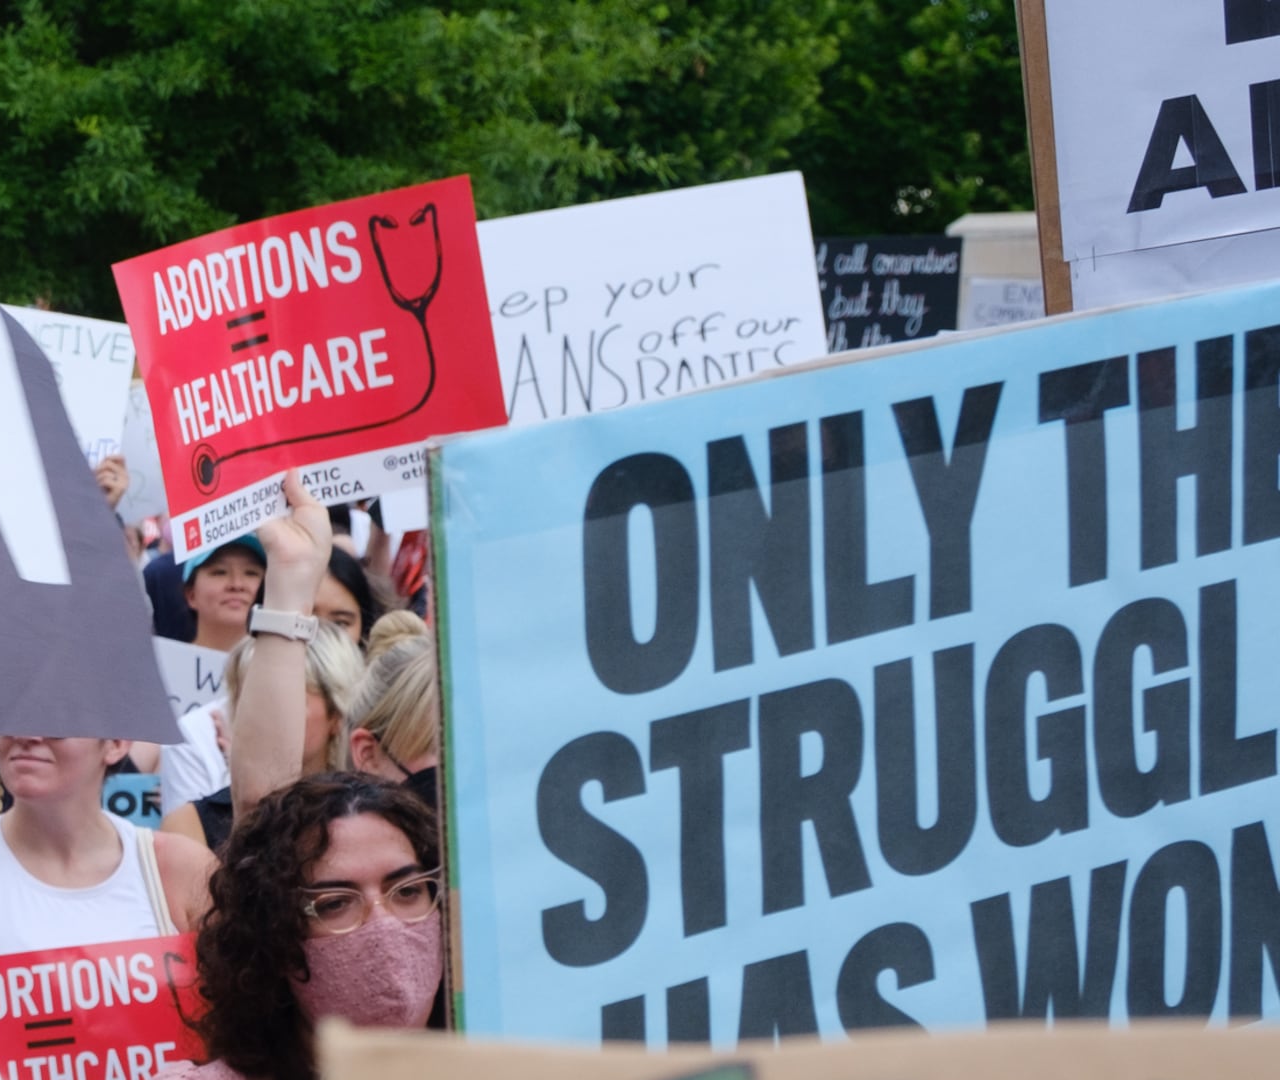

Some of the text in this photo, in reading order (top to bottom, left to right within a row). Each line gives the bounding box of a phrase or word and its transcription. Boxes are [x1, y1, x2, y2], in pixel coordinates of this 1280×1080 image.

[152, 220, 363, 335] ABORTIONS
[605, 263, 721, 318] your
[638, 312, 801, 354] off our
[173, 328, 395, 445] HEALTHCARE
[203, 467, 341, 528] ATLANTA DEMOCATIC
[205, 512, 262, 544] SOCIALISTS
[265, 501, 278, 516] OF
[582, 380, 1005, 695] ONLY
[536, 579, 1279, 968] STRUGGL
